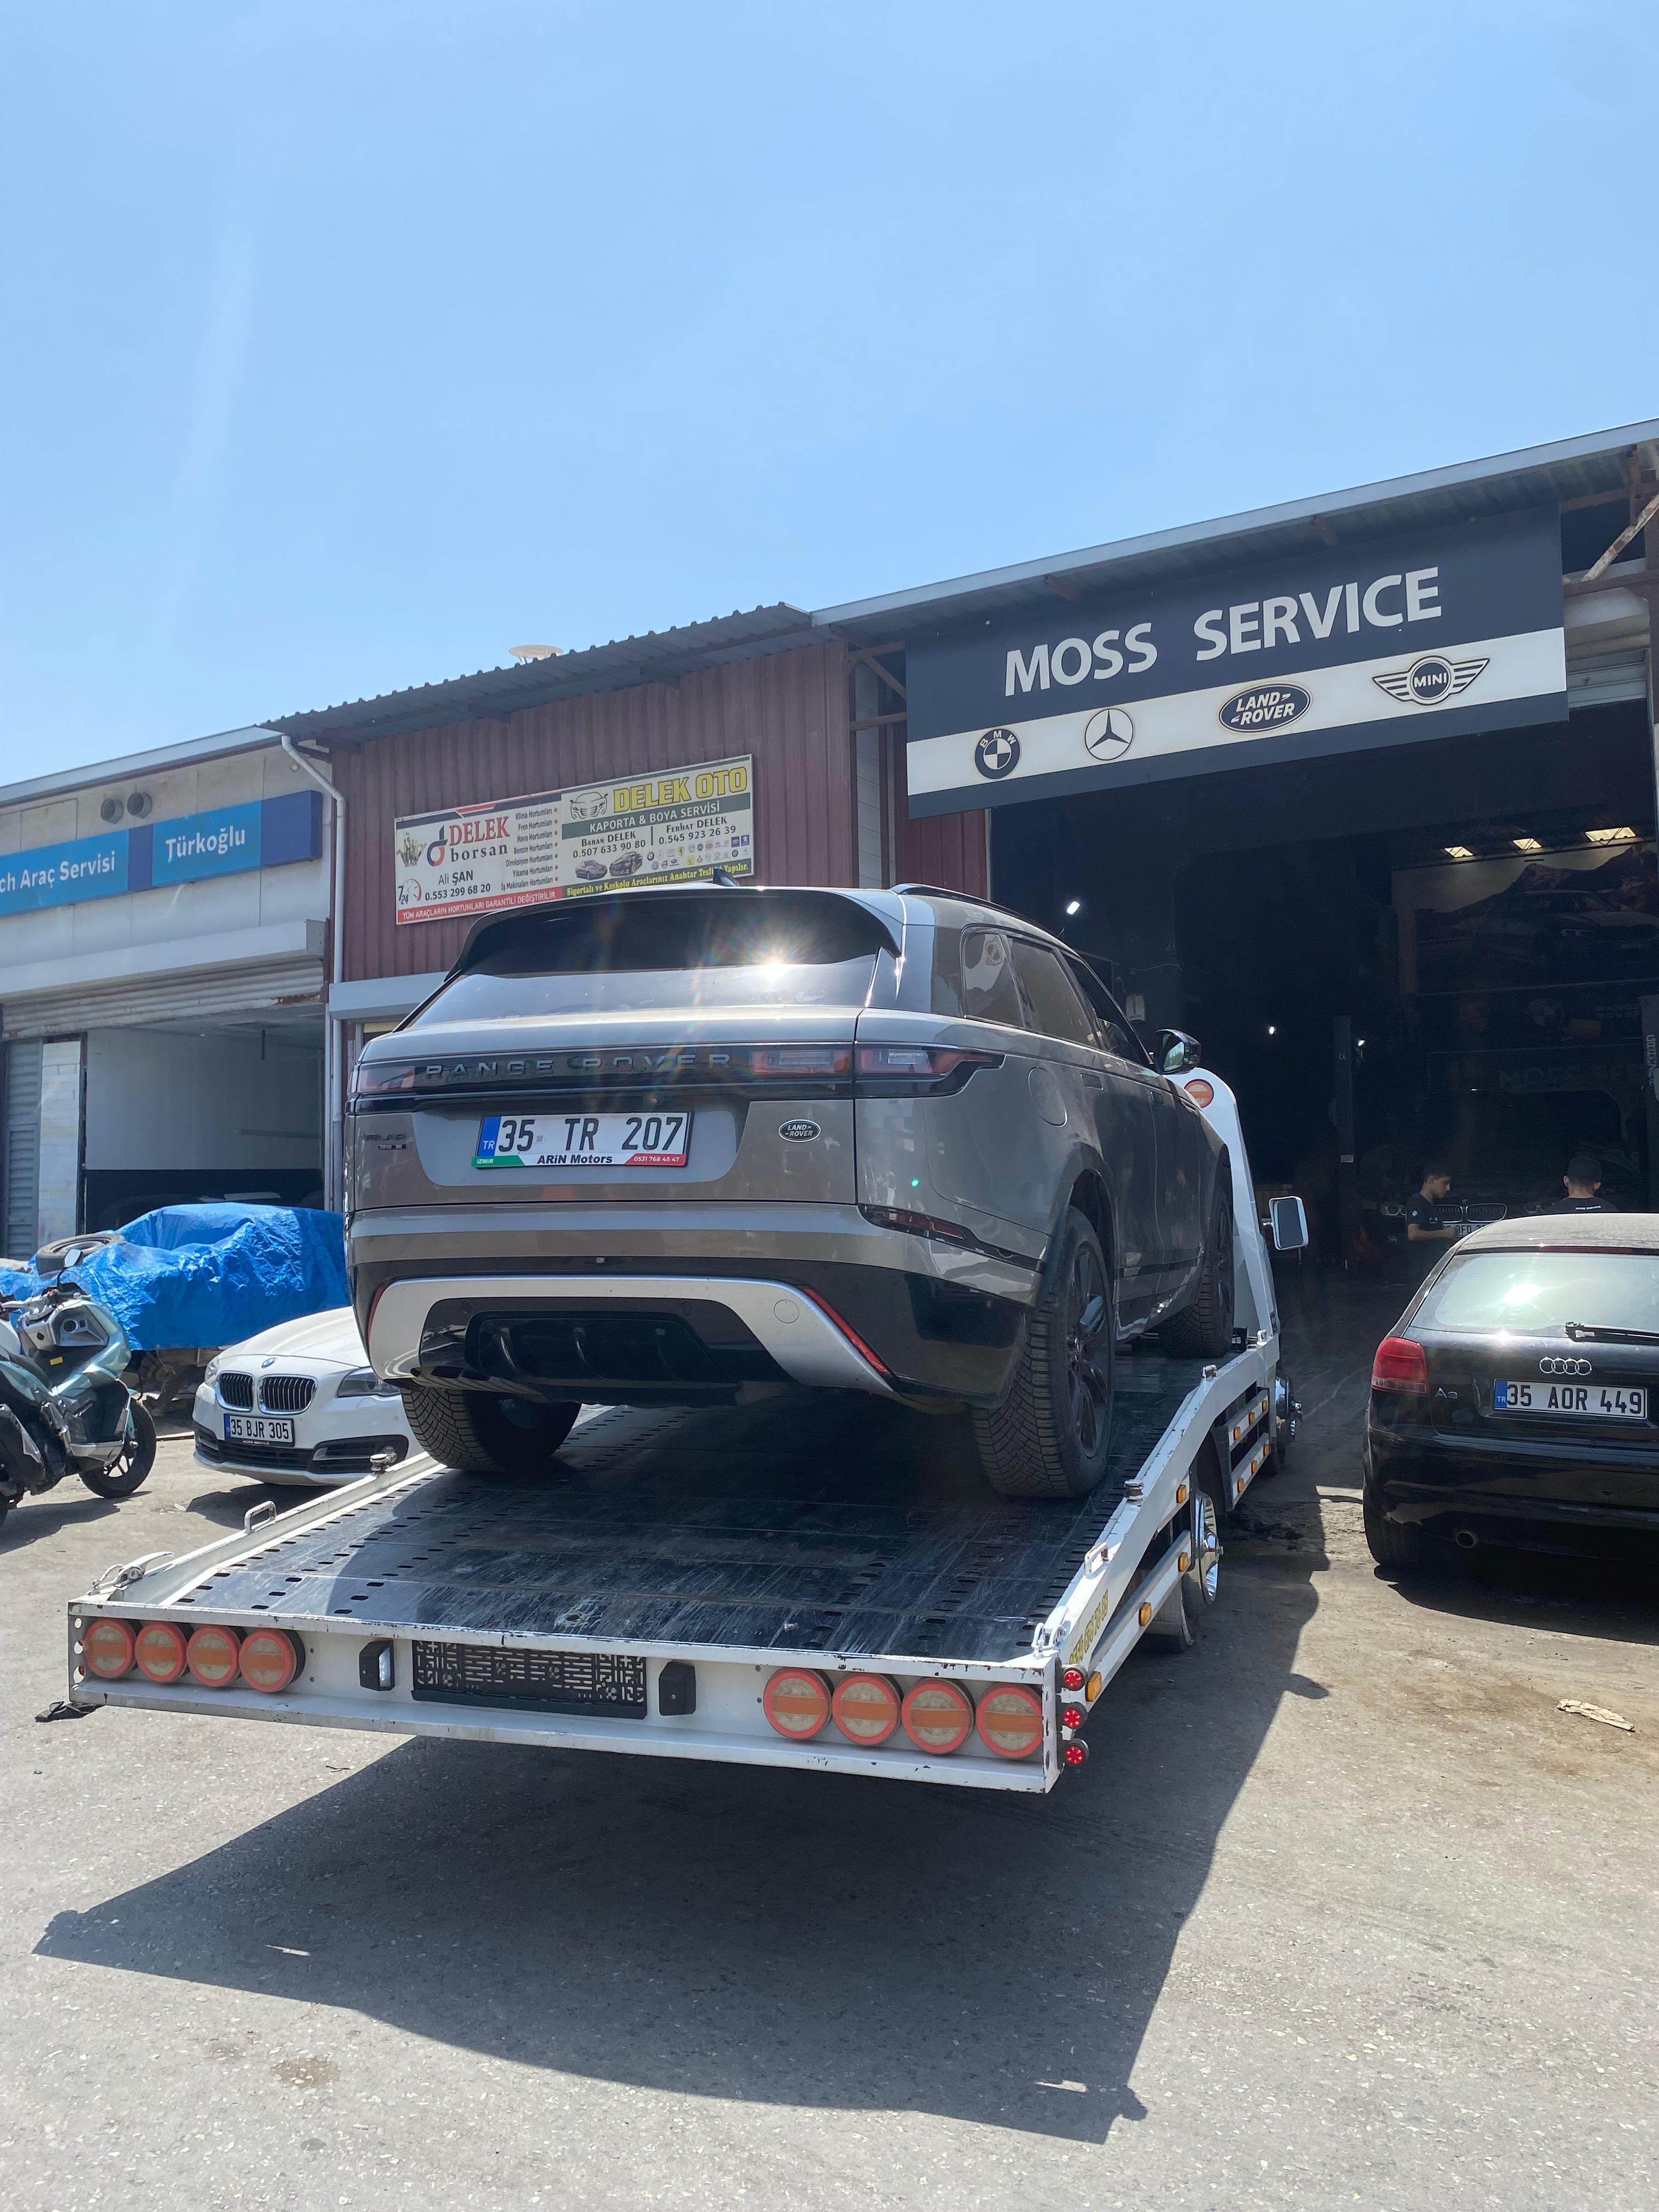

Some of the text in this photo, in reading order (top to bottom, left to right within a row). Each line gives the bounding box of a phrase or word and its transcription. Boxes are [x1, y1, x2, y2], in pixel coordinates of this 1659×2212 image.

[1005, 567, 1442, 697] MOSS SERVICE
[1414, 672, 1448, 689] MINI
[1236, 691, 1280, 712] LAND
[1240, 703, 1295, 725] ROVER
[979, 730, 1016, 748] BMW
[613, 766, 747, 813] DELEK OTO
[516, 811, 528, 820] Klima
[590, 800, 720, 833] KAPORTA & BOYA SERVİSİ
[697, 816, 727, 828] DELEK
[449, 816, 510, 846] DELEK
[607, 830, 636, 843] DELEK
[659, 825, 736, 845] 0.545 923 26 39
[166, 825, 245, 861] Türkoğlu
[450, 844, 508, 862] borsan
[514, 846, 528, 854] Benzin
[573, 839, 646, 858] 0.507 633 90 80
[20, 868, 55, 889] Araç
[59, 850, 115, 881] Servisi
[506, 857, 528, 867] Direksiyon
[438, 870, 473, 886] Ali ŞAN
[567, 885, 594, 896] Sigortalı
[604, 879, 630, 891] Kaskolu
[669, 871, 697, 882] Anahtar
[425, 883, 490, 901] 0.553 299 68 20
[403, 911, 414, 920] TÜM
[415, 907, 447, 918] ARAÇLARIN
[448, 902, 484, 913] HORTUMLARI
[486, 895, 516, 908] GARANTİLİ
[425, 1054, 731, 1080] RANGE ROVER
[499, 1117, 683, 1152] 35 TR 207
[483, 1141, 495, 1149] TR
[571, 1154, 613, 1164] Motors
[1435, 1387, 1458, 1398] A3
[1506, 1384, 1641, 1414] 35 AOR 449
[231, 1419, 289, 1440] 35 BJR 305
